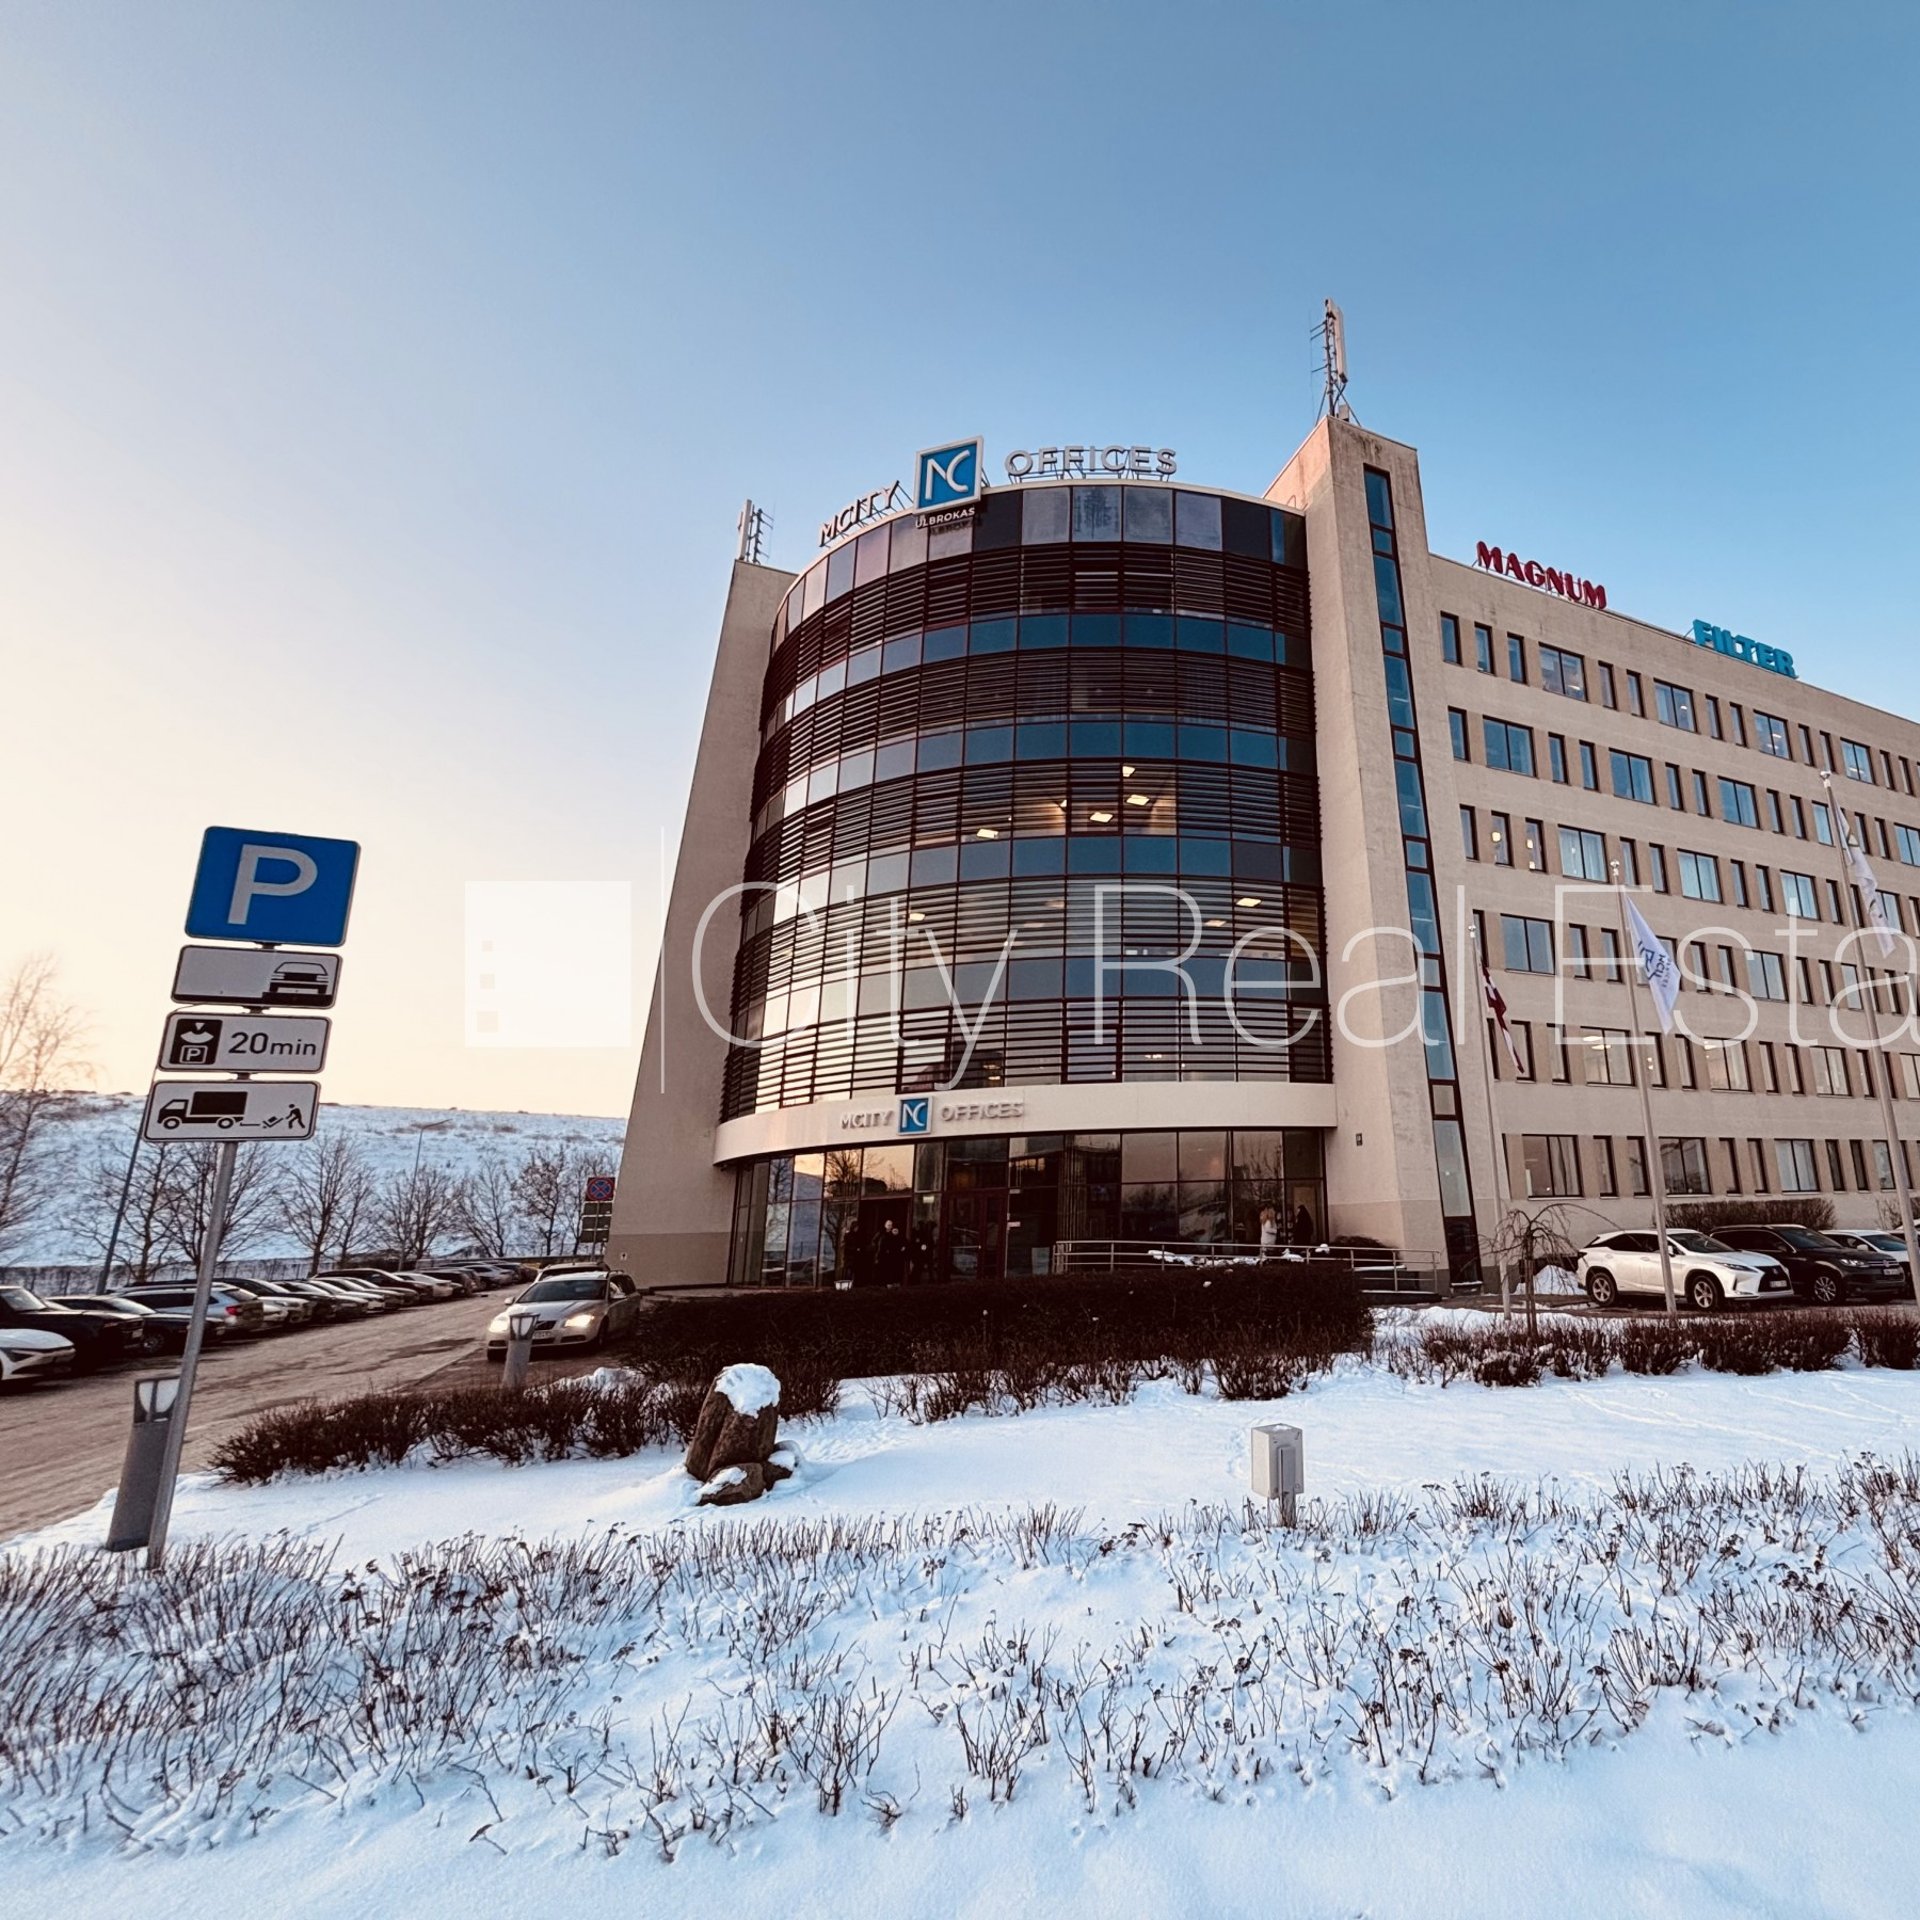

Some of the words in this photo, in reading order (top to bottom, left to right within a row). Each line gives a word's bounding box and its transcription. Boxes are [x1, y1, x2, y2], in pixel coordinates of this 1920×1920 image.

[818, 480, 899, 548] MCITY
[1004, 445, 1178, 476] OFFICES
[1476, 540, 1607, 610] MAGNUM
[1692, 619, 1799, 680] FILTER
[227, 843, 318, 925] P
[186, 1048, 201, 1061] P
[841, 1110, 895, 1130] MCITY
[940, 1101, 1025, 1122] OFFICES
